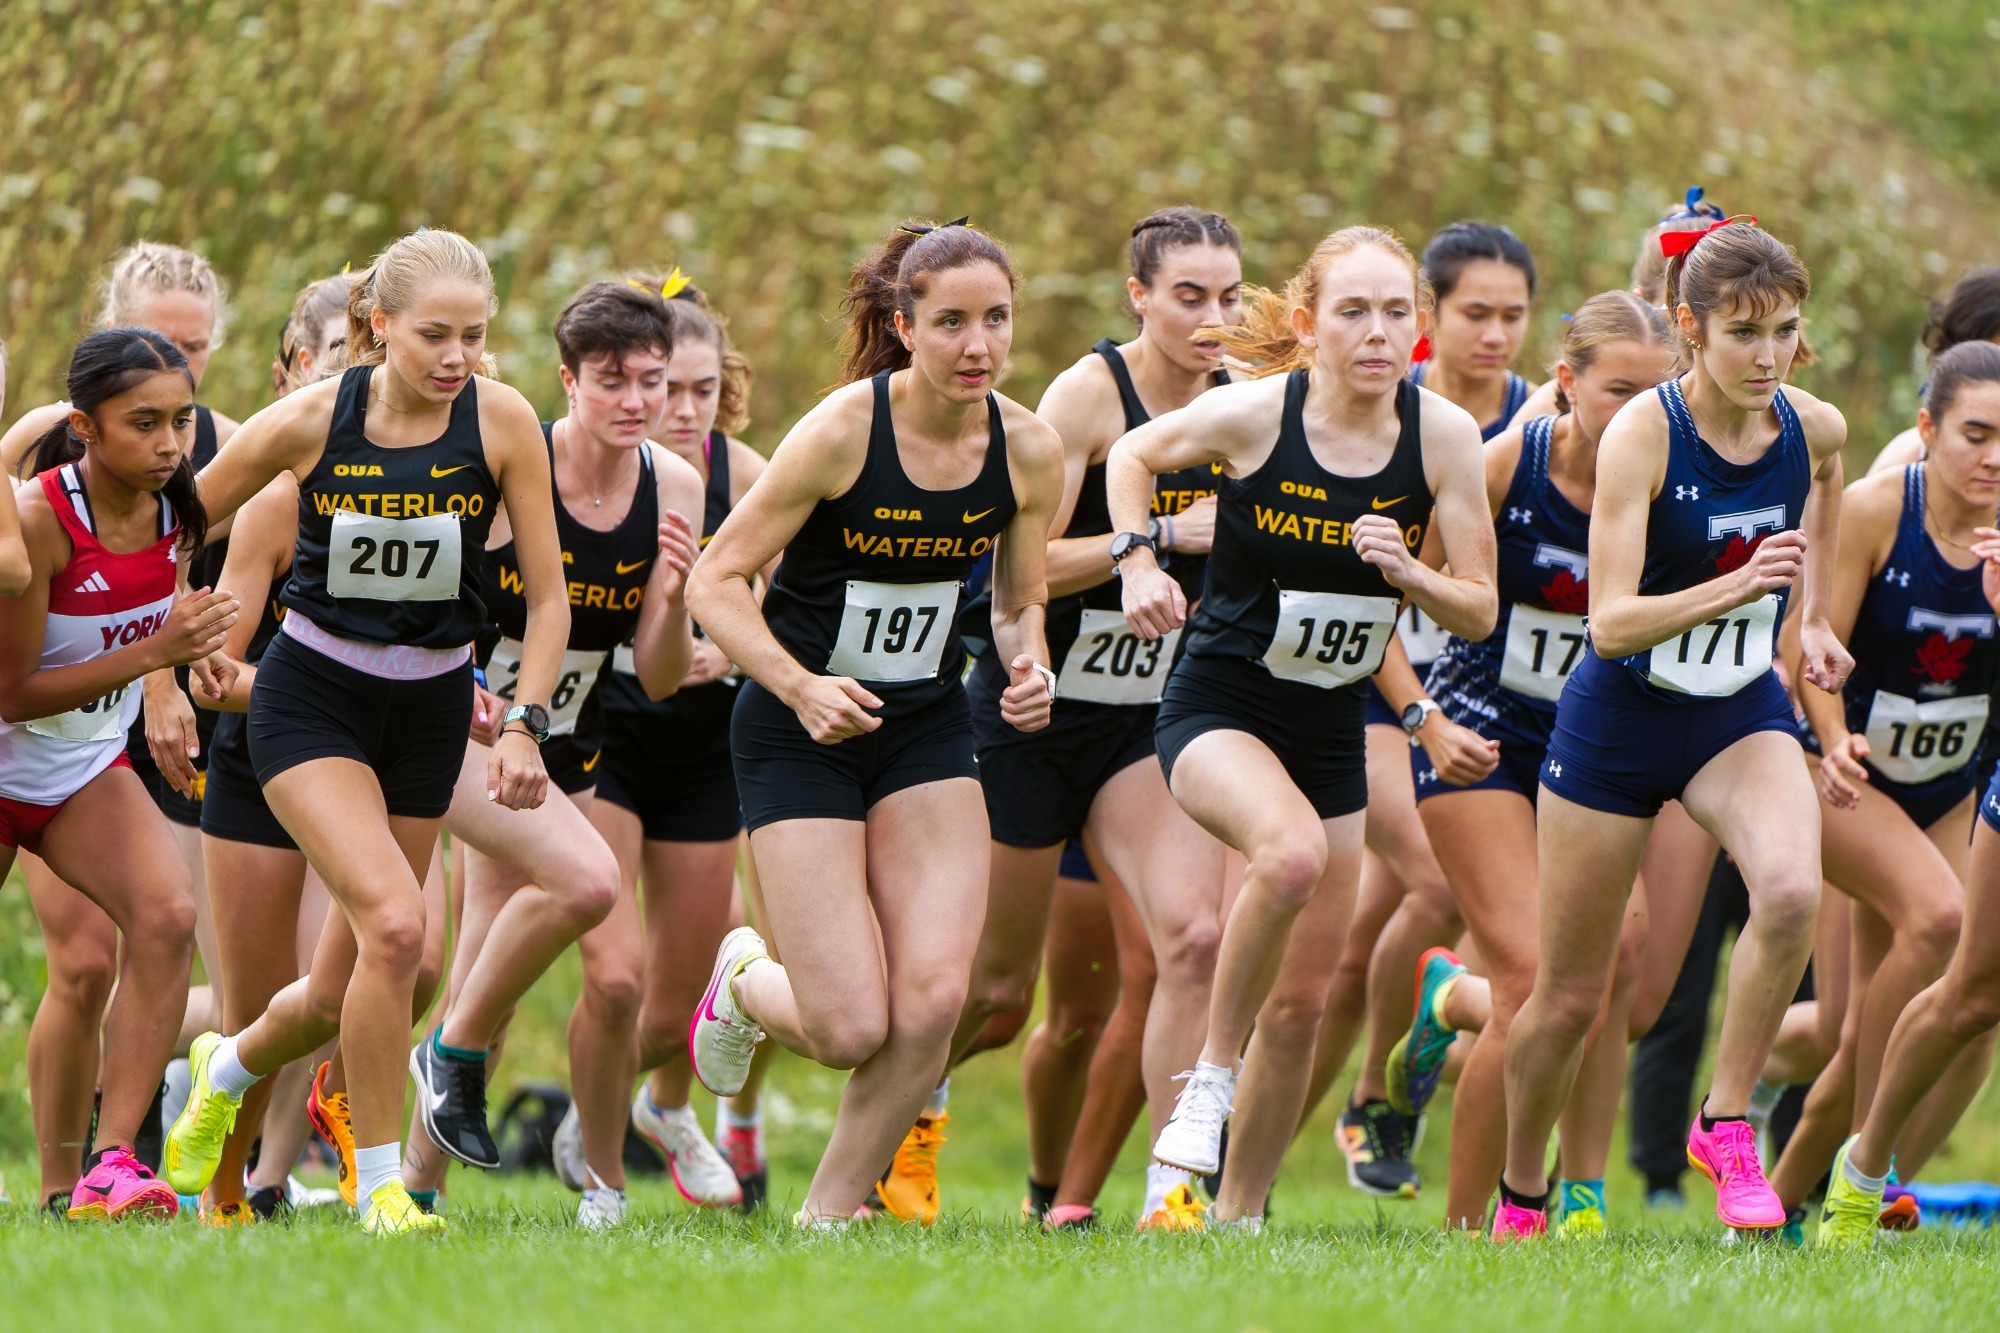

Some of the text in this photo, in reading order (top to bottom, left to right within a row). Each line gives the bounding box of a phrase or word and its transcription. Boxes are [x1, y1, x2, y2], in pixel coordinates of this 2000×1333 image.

[333, 464, 384, 477] OUA
[1280, 481, 1328, 501] OUA
[312, 492, 484, 517] WATERLOO
[874, 507, 923, 521] OUA
[1254, 504, 1421, 548] WATERO
[349, 536, 440, 579] 207
[843, 527, 1001, 558] WATERLO
[500, 565, 645, 610] WERLO
[100, 608, 168, 650] YORK
[862, 606, 940, 654] 197
[1293, 617, 1375, 665] 195
[1677, 618, 1751, 667] 171
[1081, 631, 1164, 678] 203
[1530, 628, 1585, 676] 17
[497, 660, 581, 710] 26
[1889, 720, 1967, 759] 166
